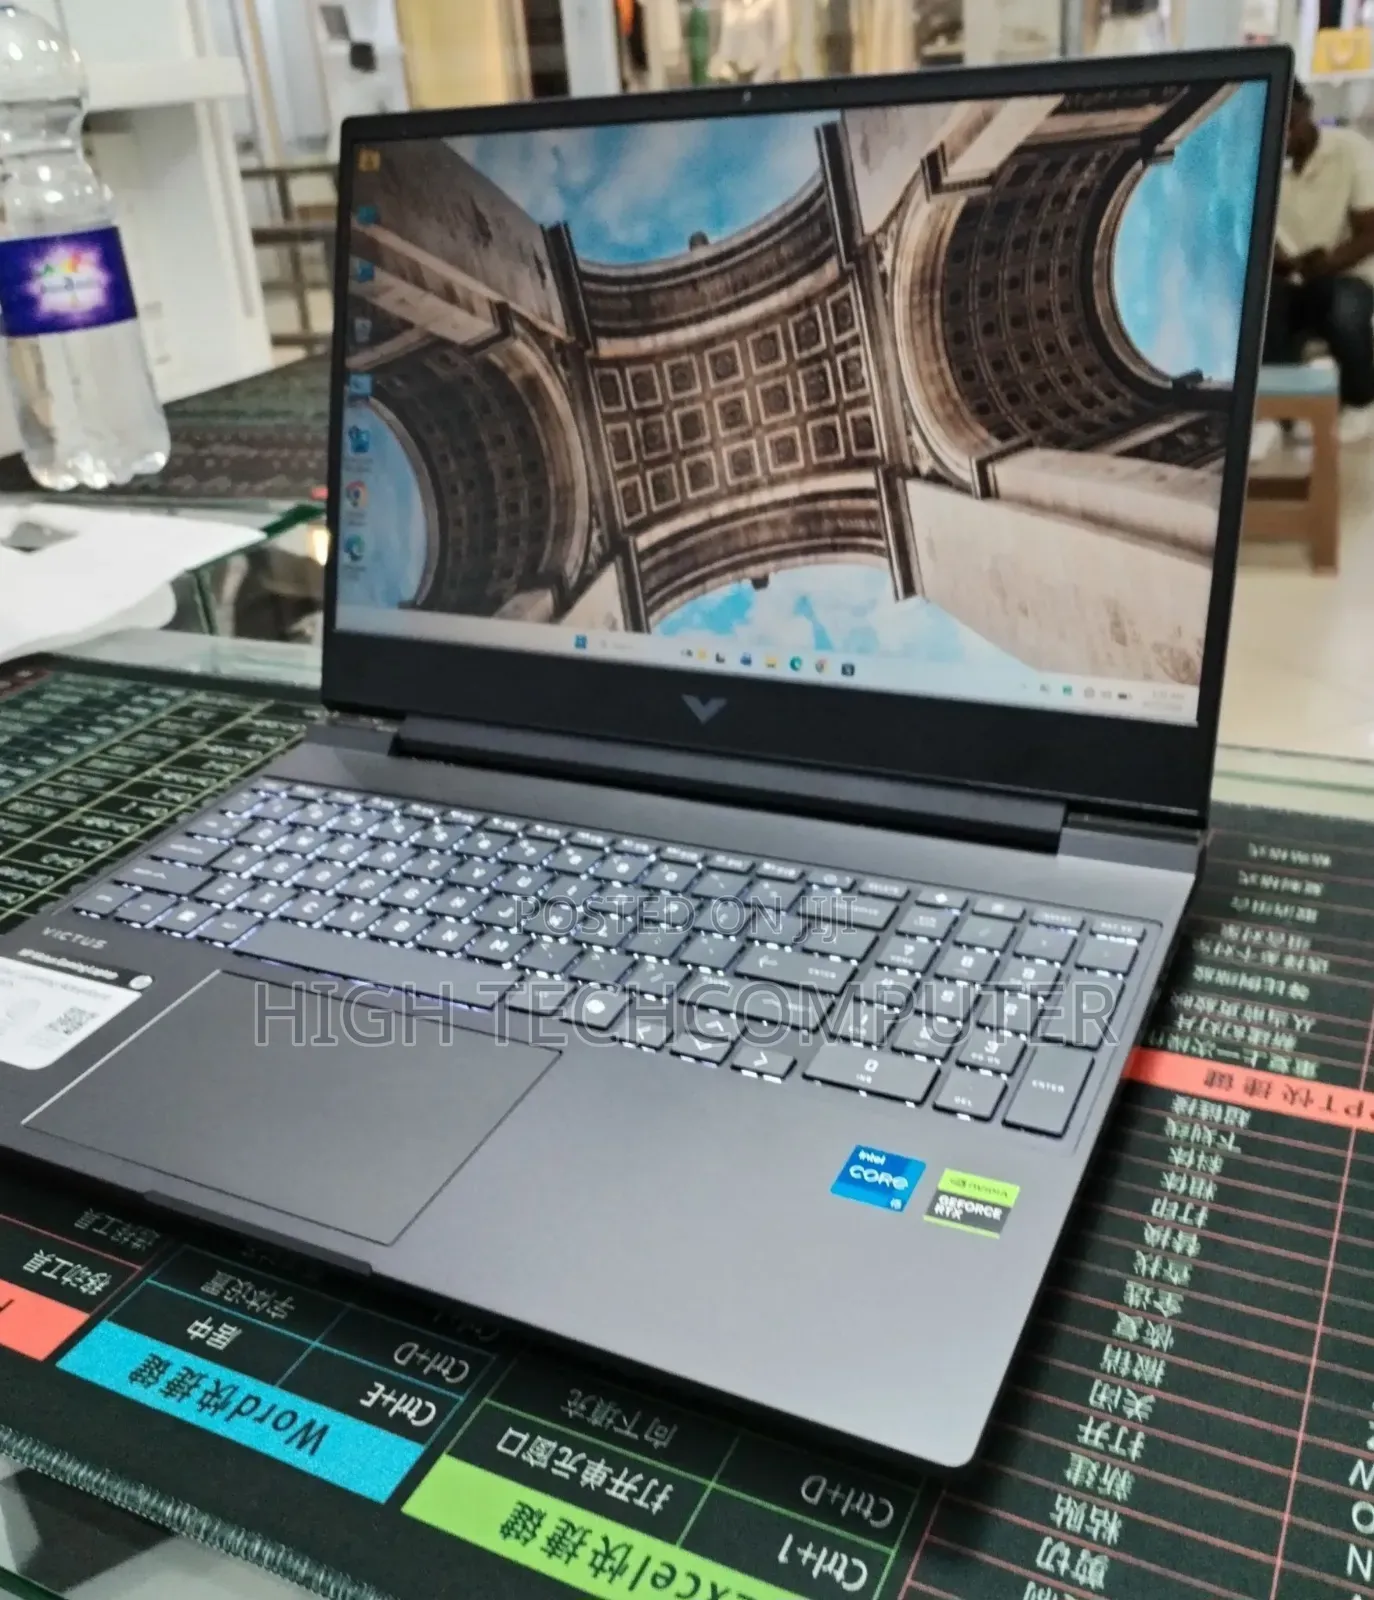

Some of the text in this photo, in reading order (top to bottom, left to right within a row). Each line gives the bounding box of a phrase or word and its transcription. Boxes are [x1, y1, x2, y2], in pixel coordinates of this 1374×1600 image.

[41, 926, 108, 950] VICTUS
[1031, 1078, 1065, 1093] ENTER
[934, 1203, 964, 1221] RTX
[938, 1194, 1003, 1221] GEFORCE
[1151, 1196, 1208, 1228] 打印
[22, 1249, 113, 1296] 移动工具
[187, 1315, 242, 1351] 居中
[394, 1342, 470, 1385] Ctrl+D
[1101, 1344, 1166, 1388] 撤销
[128, 1353, 333, 1458] Word快捷键
[358, 1381, 437, 1428] Ctrl+E
[565, 1388, 679, 1450] 向下填充
[1089, 1379, 1154, 1422] 关闭
[1076, 1415, 1145, 1462] 打开
[495, 1425, 674, 1516] 打开单元窗口
[1065, 1452, 1136, 1501] 新建
[799, 1474, 894, 1530] Ctrl+D
[1050, 1493, 1122, 1546] 粘贴
[498, 1500, 750, 1600] xcel快捷键
[777, 1533, 869, 1593] Ctrl+1
[1035, 1537, 1109, 1590] 剪切
